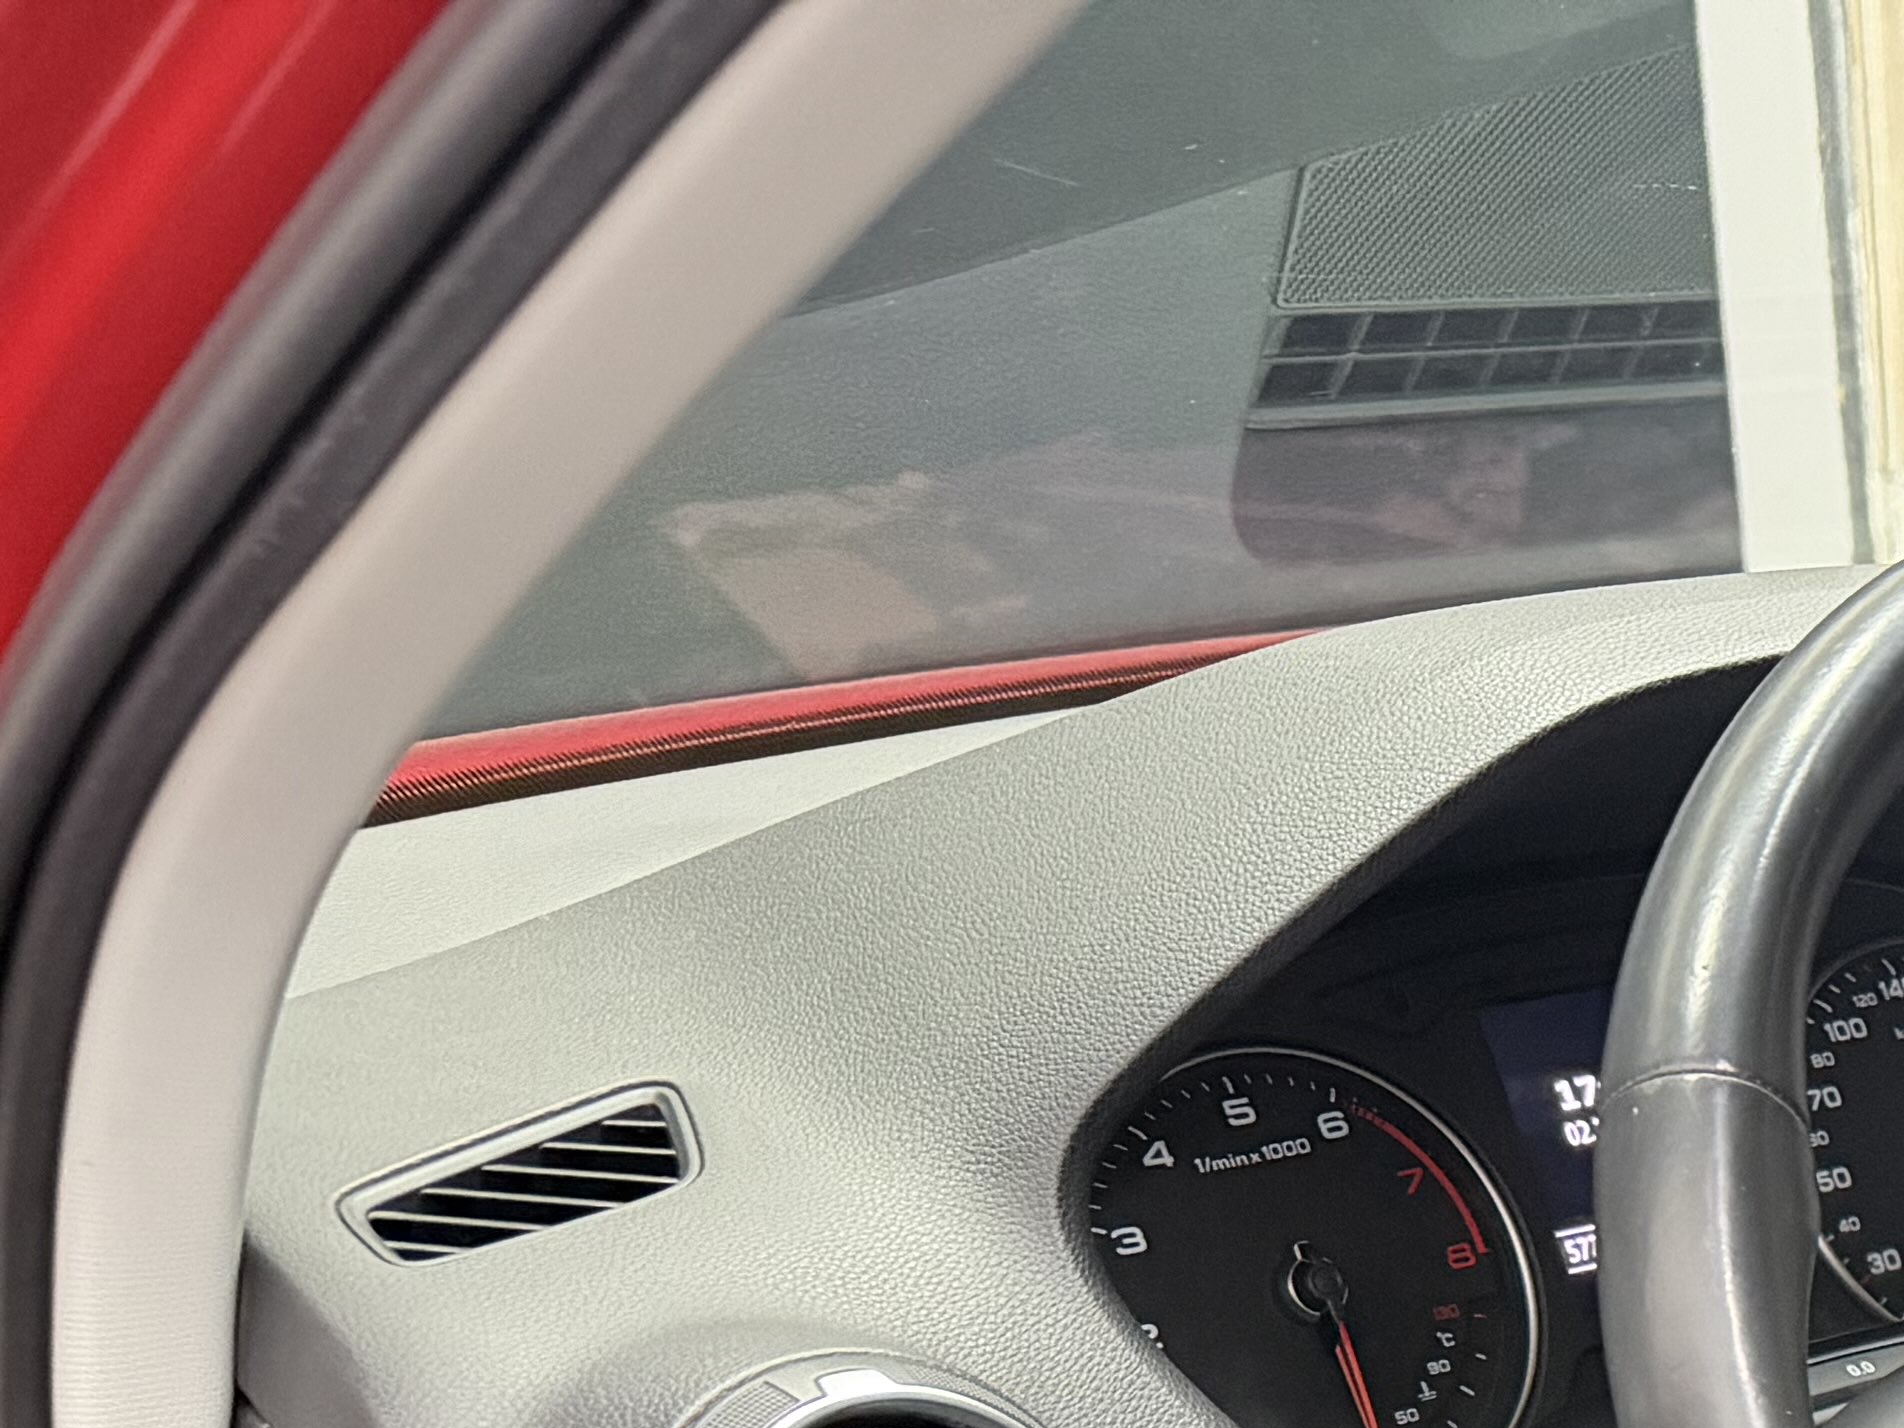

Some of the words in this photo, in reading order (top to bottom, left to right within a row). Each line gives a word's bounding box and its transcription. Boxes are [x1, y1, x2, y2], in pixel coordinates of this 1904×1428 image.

[1852, 990, 1878, 1008] 120
[1823, 1017, 1868, 1042] 100
[1809, 1051, 1835, 1068] 80
[1221, 1097, 1257, 1127] 5
[1807, 1086, 1842, 1112] 70
[1316, 1110, 1350, 1140] 6
[1143, 1140, 1174, 1167] 4
[1396, 1168, 1424, 1195] 7
[1816, 1166, 1852, 1193] 50
[1838, 1215, 1861, 1233] 40
[1110, 1226, 1148, 1256] 3
[1447, 1242, 1476, 1270] 8
[1866, 1247, 1903, 1275] 30
[1426, 1358, 1451, 1376] 90
[1394, 1407, 1420, 1425] 50
